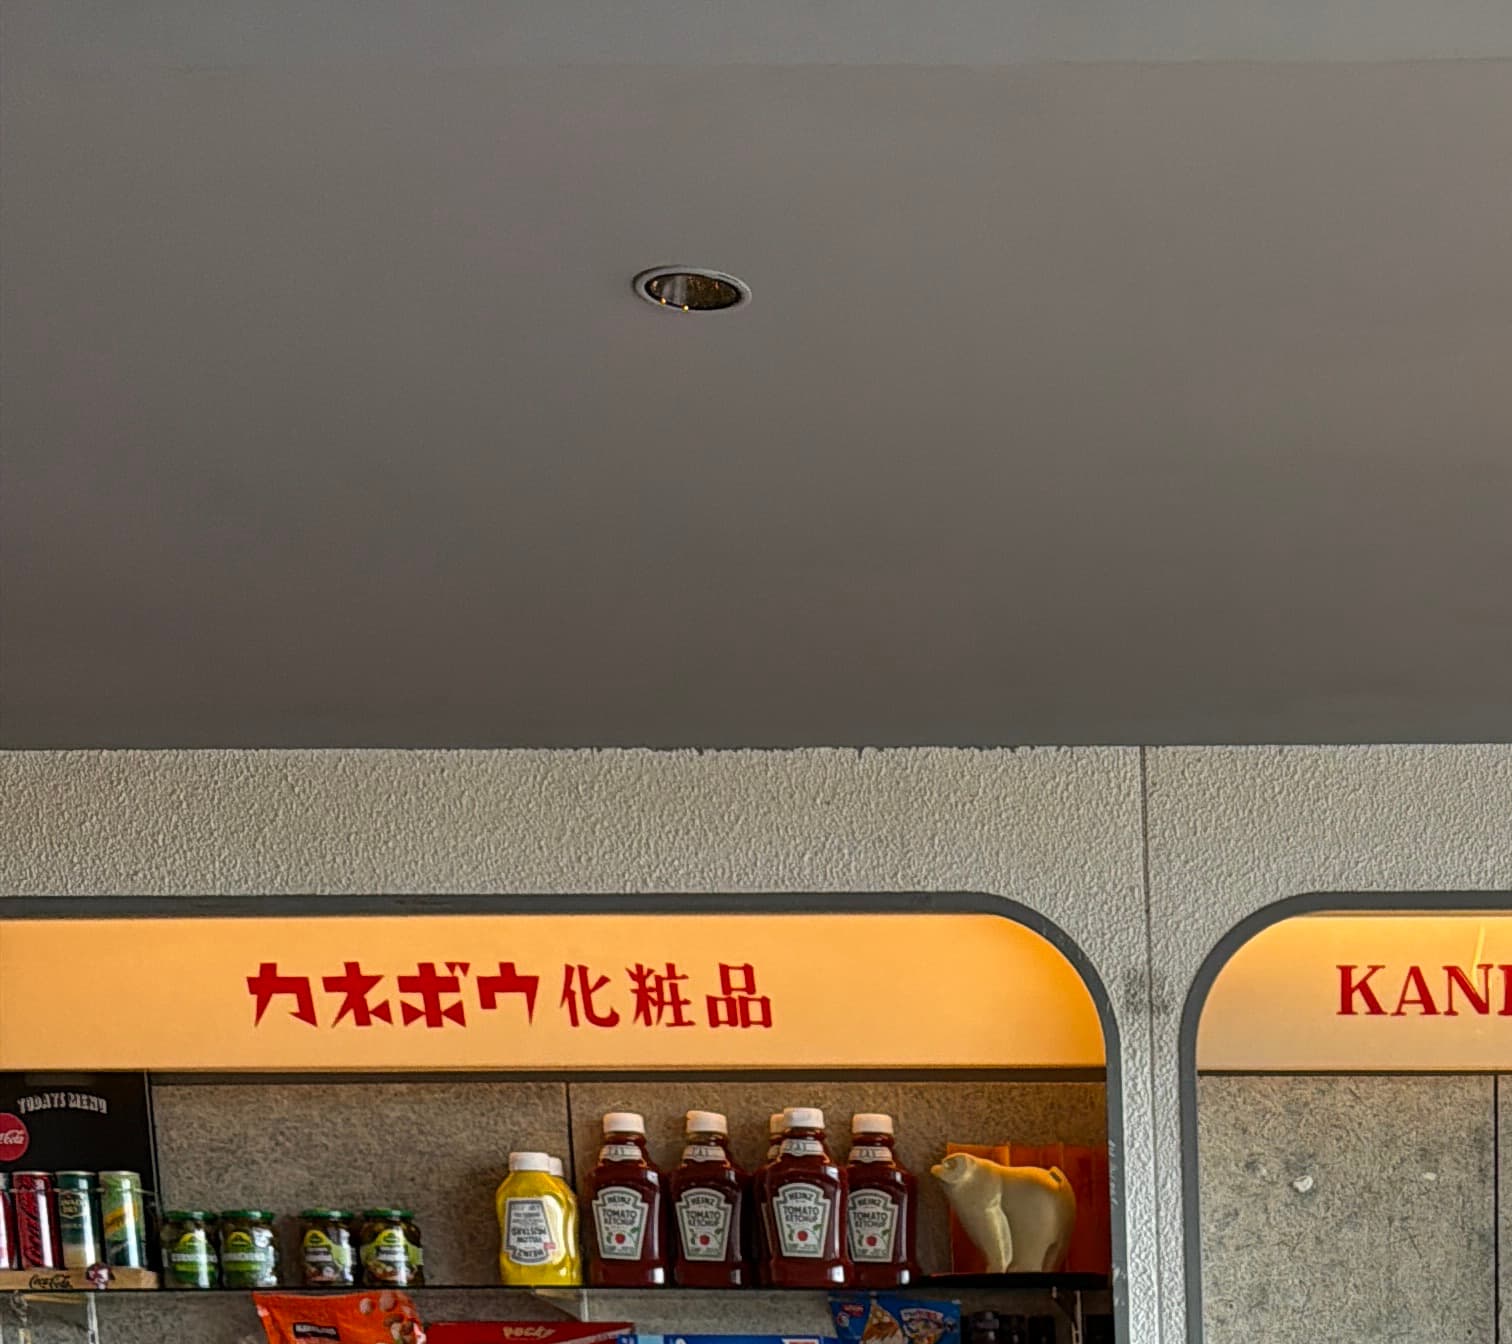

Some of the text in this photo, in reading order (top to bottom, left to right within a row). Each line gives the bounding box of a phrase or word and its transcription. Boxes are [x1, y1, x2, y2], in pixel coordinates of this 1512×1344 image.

[246, 961, 772, 1028] カネボウ化粧品
[607, 1196, 630, 1205] HEINZ
[789, 1191, 813, 1201] HEINZ
[691, 1197, 715, 1206] HEINZ
[858, 1197, 881, 1207] HEINZ
[602, 1208, 637, 1219] TOMATO
[686, 1210, 720, 1220] TOMATO
[783, 1205, 819, 1216] TOMATO
[853, 1211, 888, 1221] TOMATO
[29, 1274, 72, 1289] Coca-Cola
